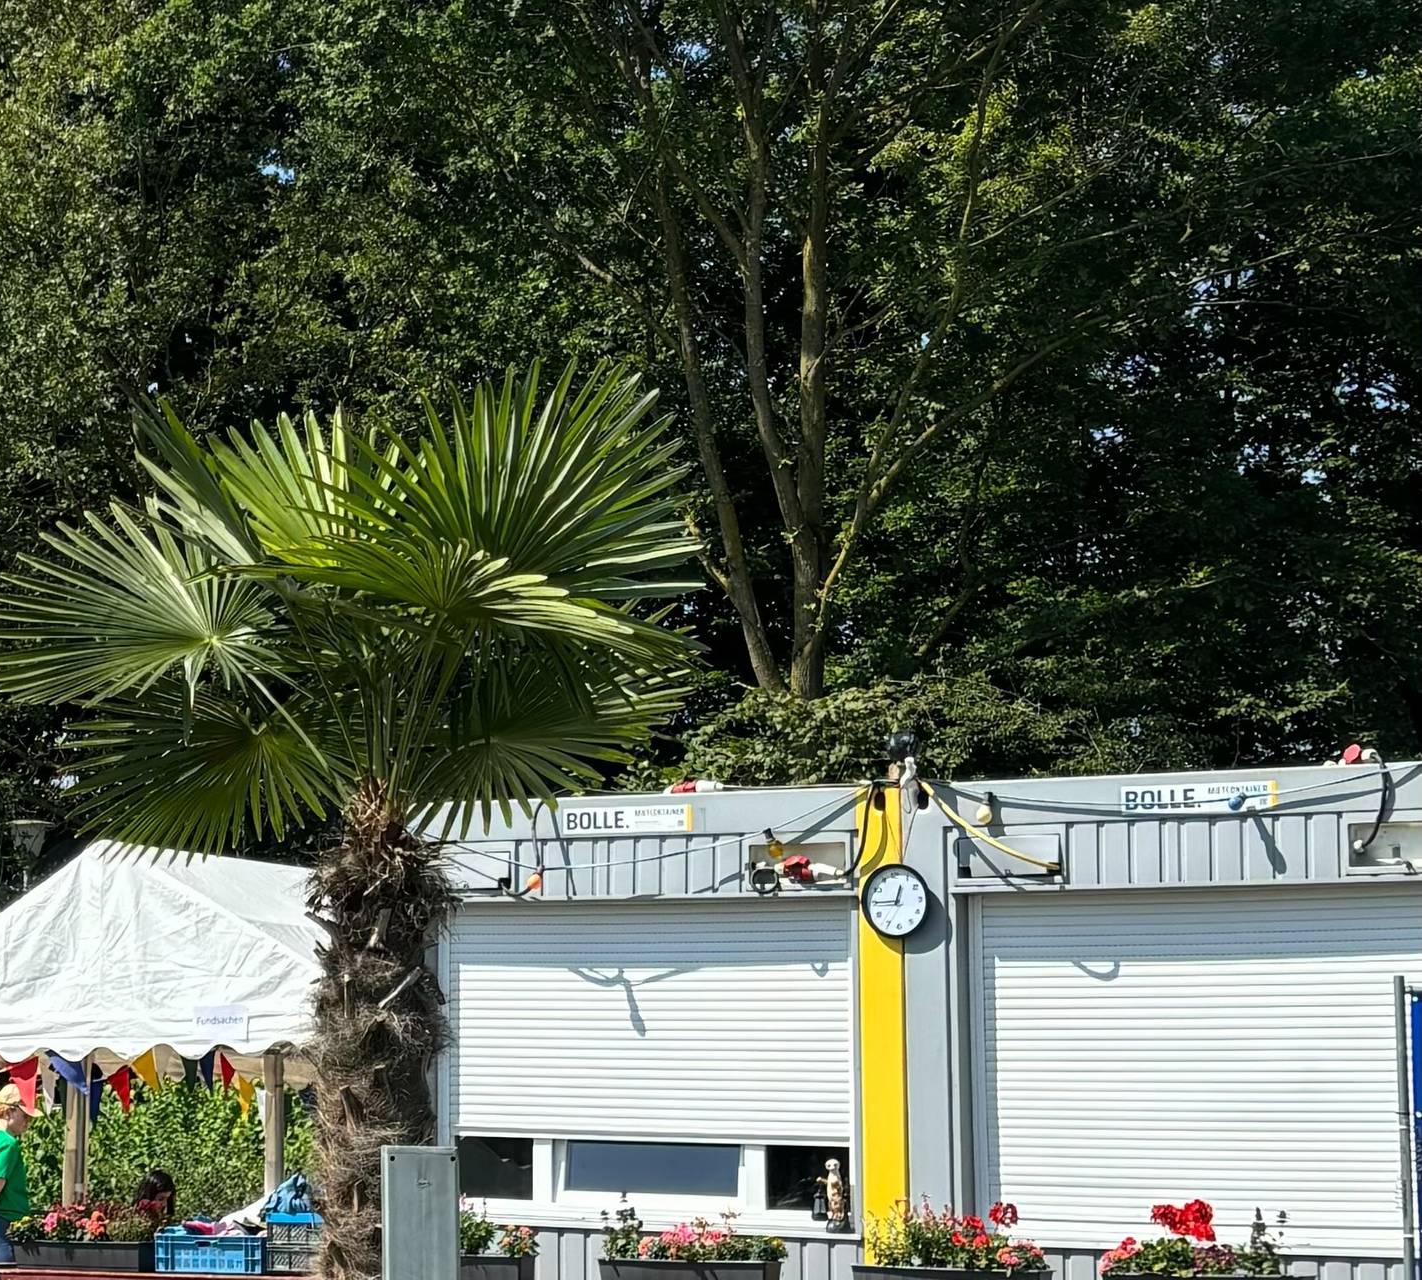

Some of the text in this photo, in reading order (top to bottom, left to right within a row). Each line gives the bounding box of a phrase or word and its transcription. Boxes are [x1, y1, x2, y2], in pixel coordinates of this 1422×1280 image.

[1125, 788, 1201, 811] BOLLE.
[566, 811, 630, 830] BOLLE.
[196, 1016, 244, 1025] Fundsachen
